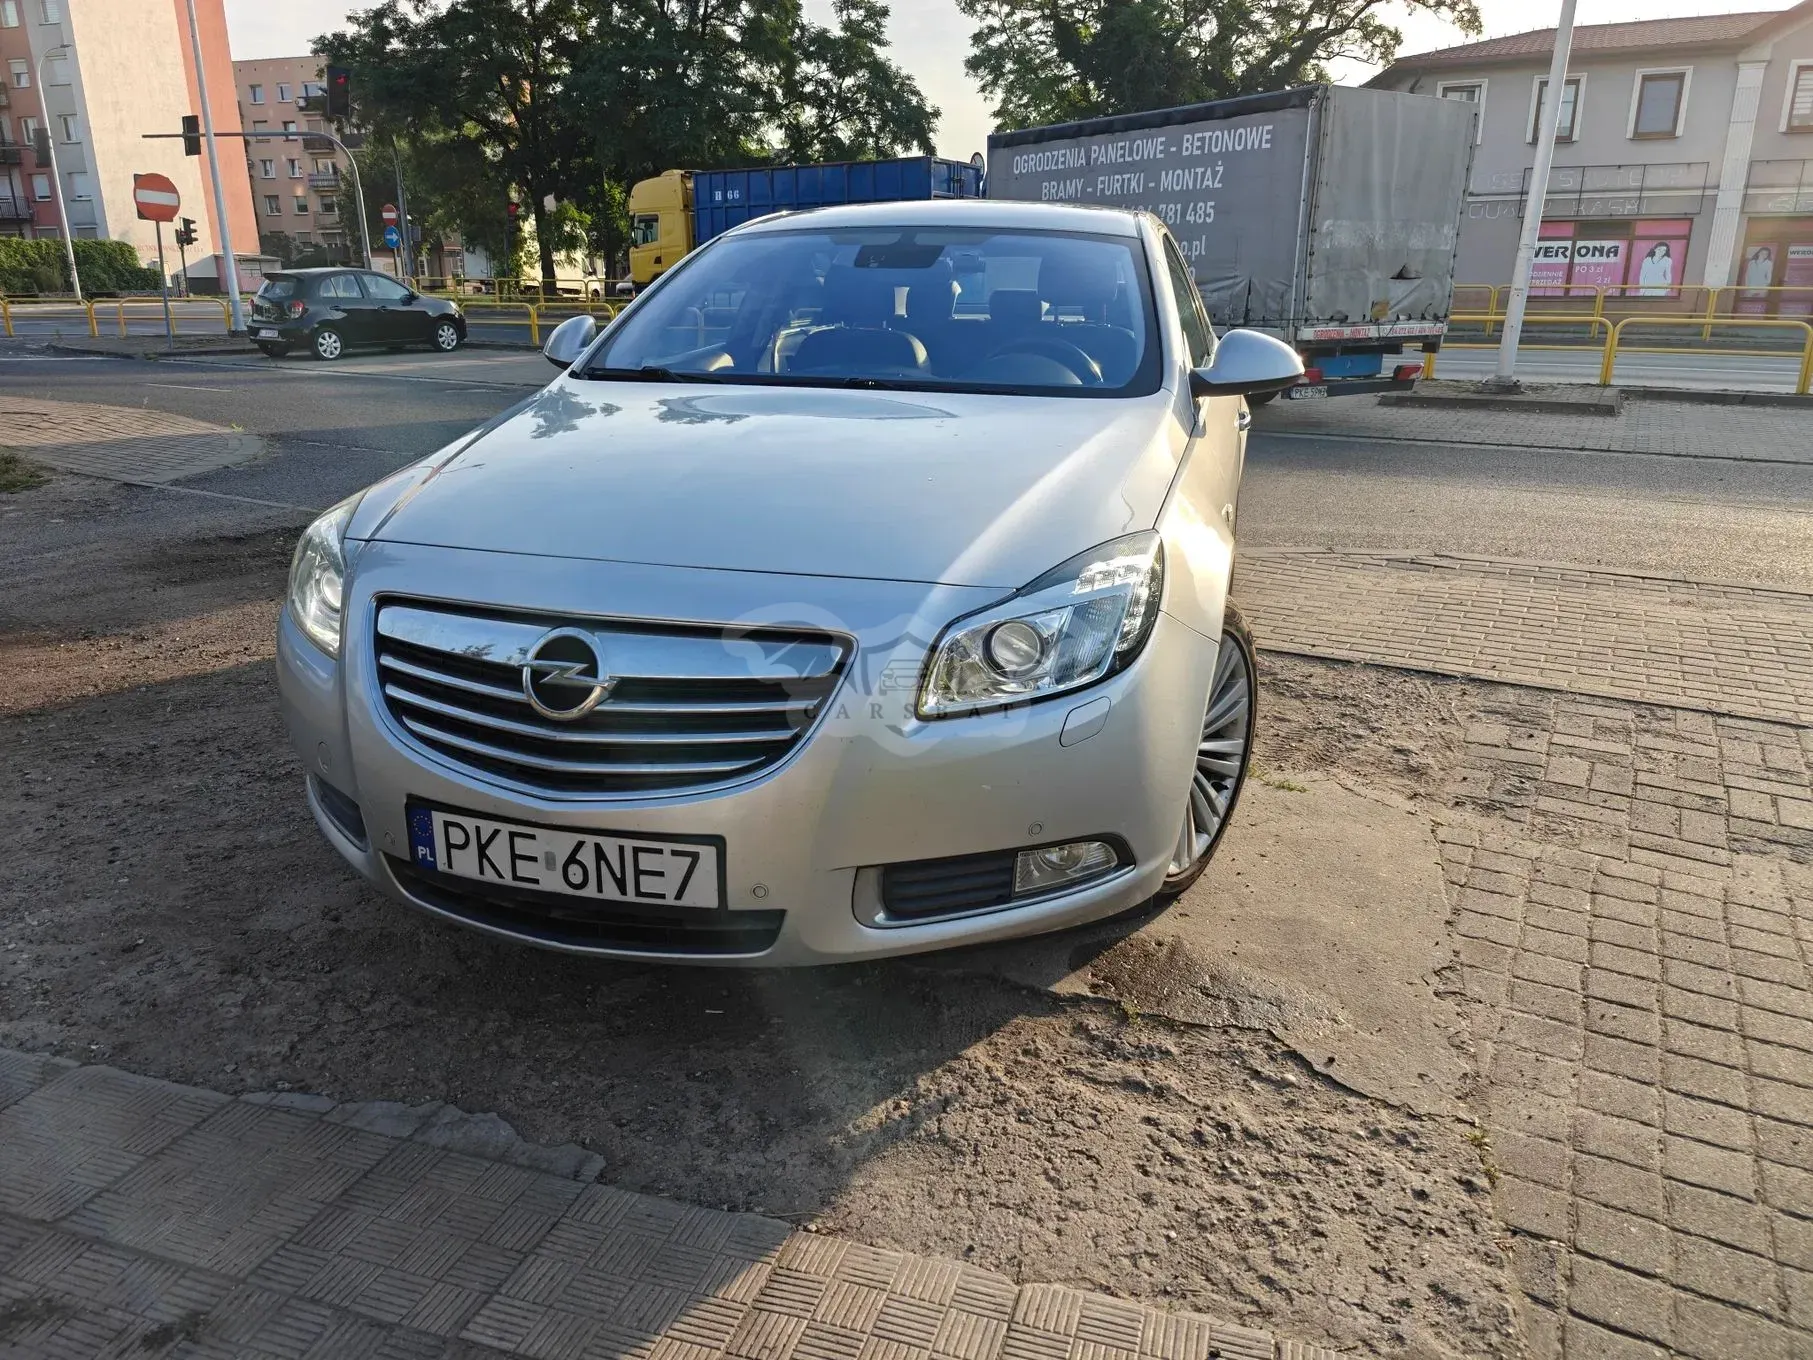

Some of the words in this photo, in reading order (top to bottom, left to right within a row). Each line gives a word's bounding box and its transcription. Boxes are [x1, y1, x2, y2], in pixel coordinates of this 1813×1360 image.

[1013, 148, 1086, 174] OGRODZENIA
[1090, 137, 1166, 166] PANELOWE
[1182, 125, 1274, 156] BETONOWE
[1041, 178, 1084, 200] BRAMY
[1097, 172, 1144, 197] FURTKI
[1160, 160, 1224, 192] MONTAŻ
[1158, 203, 1181, 225] 781
[1186, 201, 1215, 224] 485
[418, 846, 434, 862] PL
[442, 820, 540, 885] PKE
[561, 840, 701, 901] 6NE7
